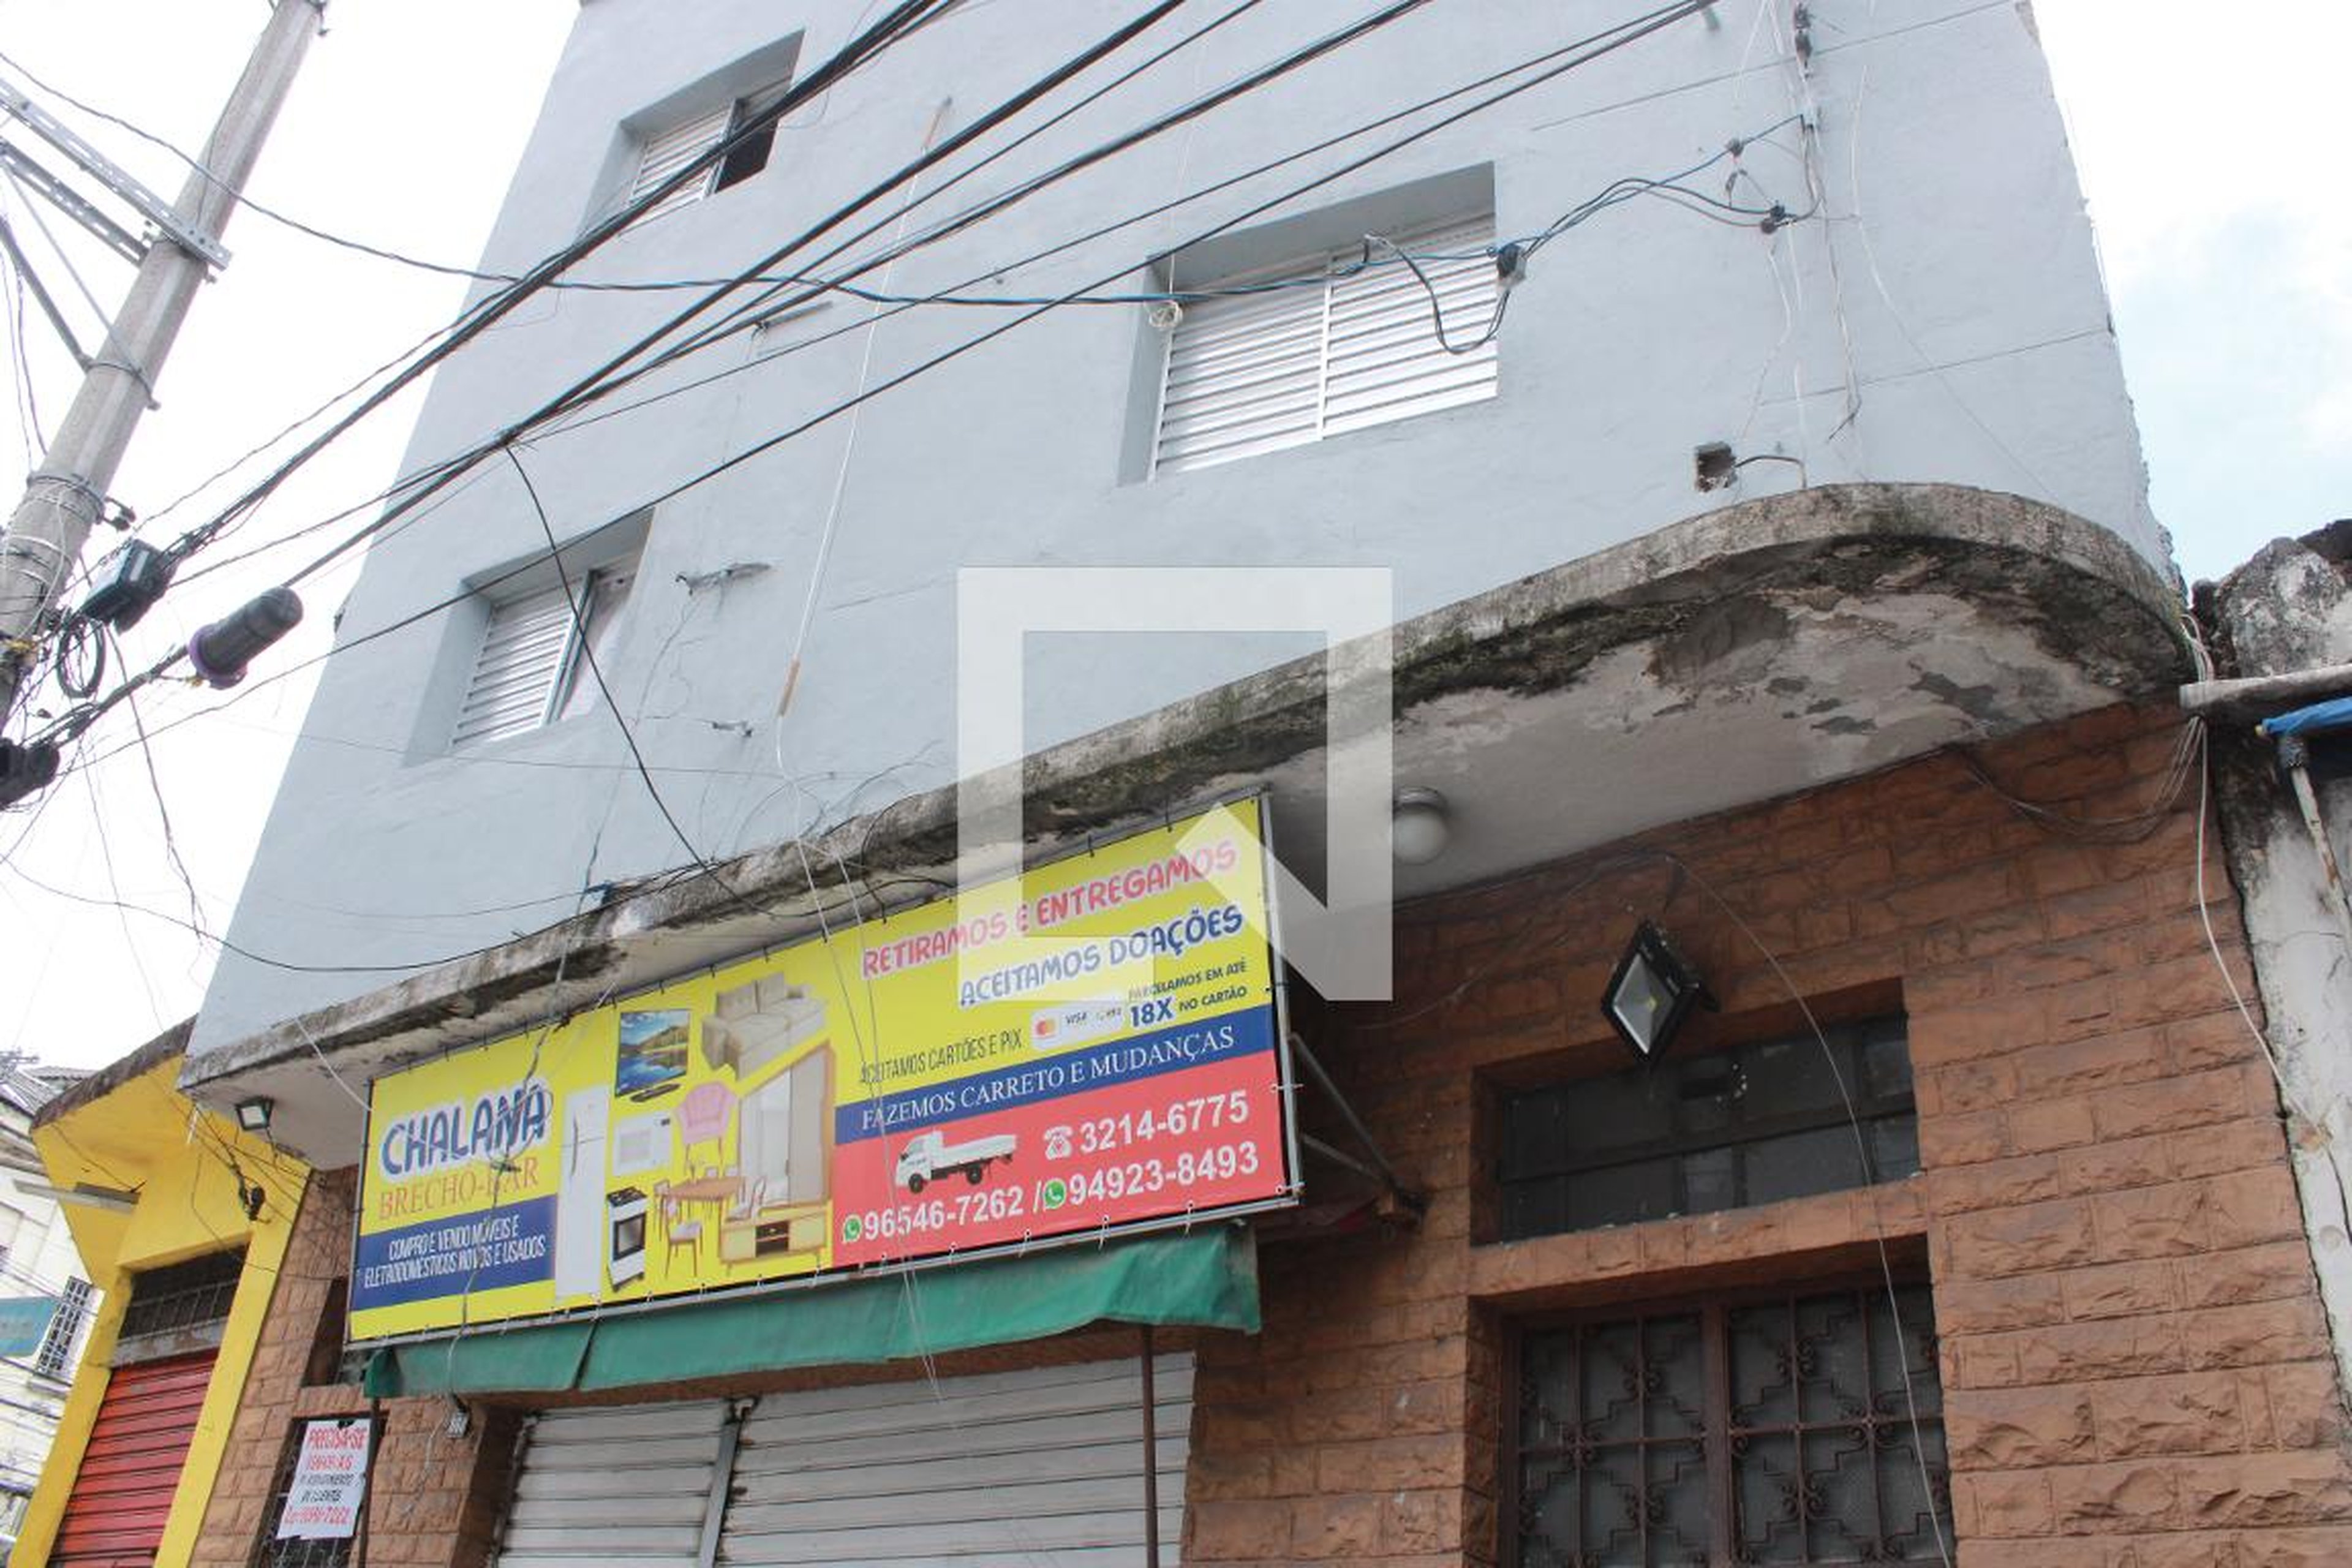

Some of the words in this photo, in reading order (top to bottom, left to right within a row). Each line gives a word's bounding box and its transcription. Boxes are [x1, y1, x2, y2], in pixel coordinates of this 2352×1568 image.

[862, 913, 1006, 979] RETIRAMOS
[1016, 903, 1030, 932] E
[1037, 841, 1237, 925] ENTREGAMOS
[960, 945, 1101, 1006] ACEITAMOS
[1110, 905, 1243, 964] DOAÇÕES
[1205, 965, 1223, 981] EM
[1226, 957, 1247, 976] ATÉ
[1130, 997, 1175, 1027] 18X
[1179, 997, 1199, 1012] NO
[1202, 986, 1248, 1008] CARTÃO
[861, 1091, 956, 1131] FAZEMOS
[960, 1072, 1065, 1110] CARRETO
[1071, 1065, 1085, 1084] E
[1090, 1025, 1235, 1078] MUDANÇAS
[929, 1034, 987, 1071] CARTÕES
[989, 1034, 998, 1055] E
[1001, 1028, 1023, 1052] PIX
[382, 1088, 545, 1175] CHALANA
[1080, 1089, 1250, 1155] 3214-6775
[865, 1186, 1024, 1239] 96546-7262
[1069, 1140, 1260, 1206] 94923-8493
[389, 1233, 428, 1261] COMPRO
[429, 1232, 437, 1253] E
[438, 1224, 470, 1251] VENDO
[512, 1214, 519, 1237] E
[494, 1242, 502, 1265] E
[503, 1234, 546, 1264] USADOS
